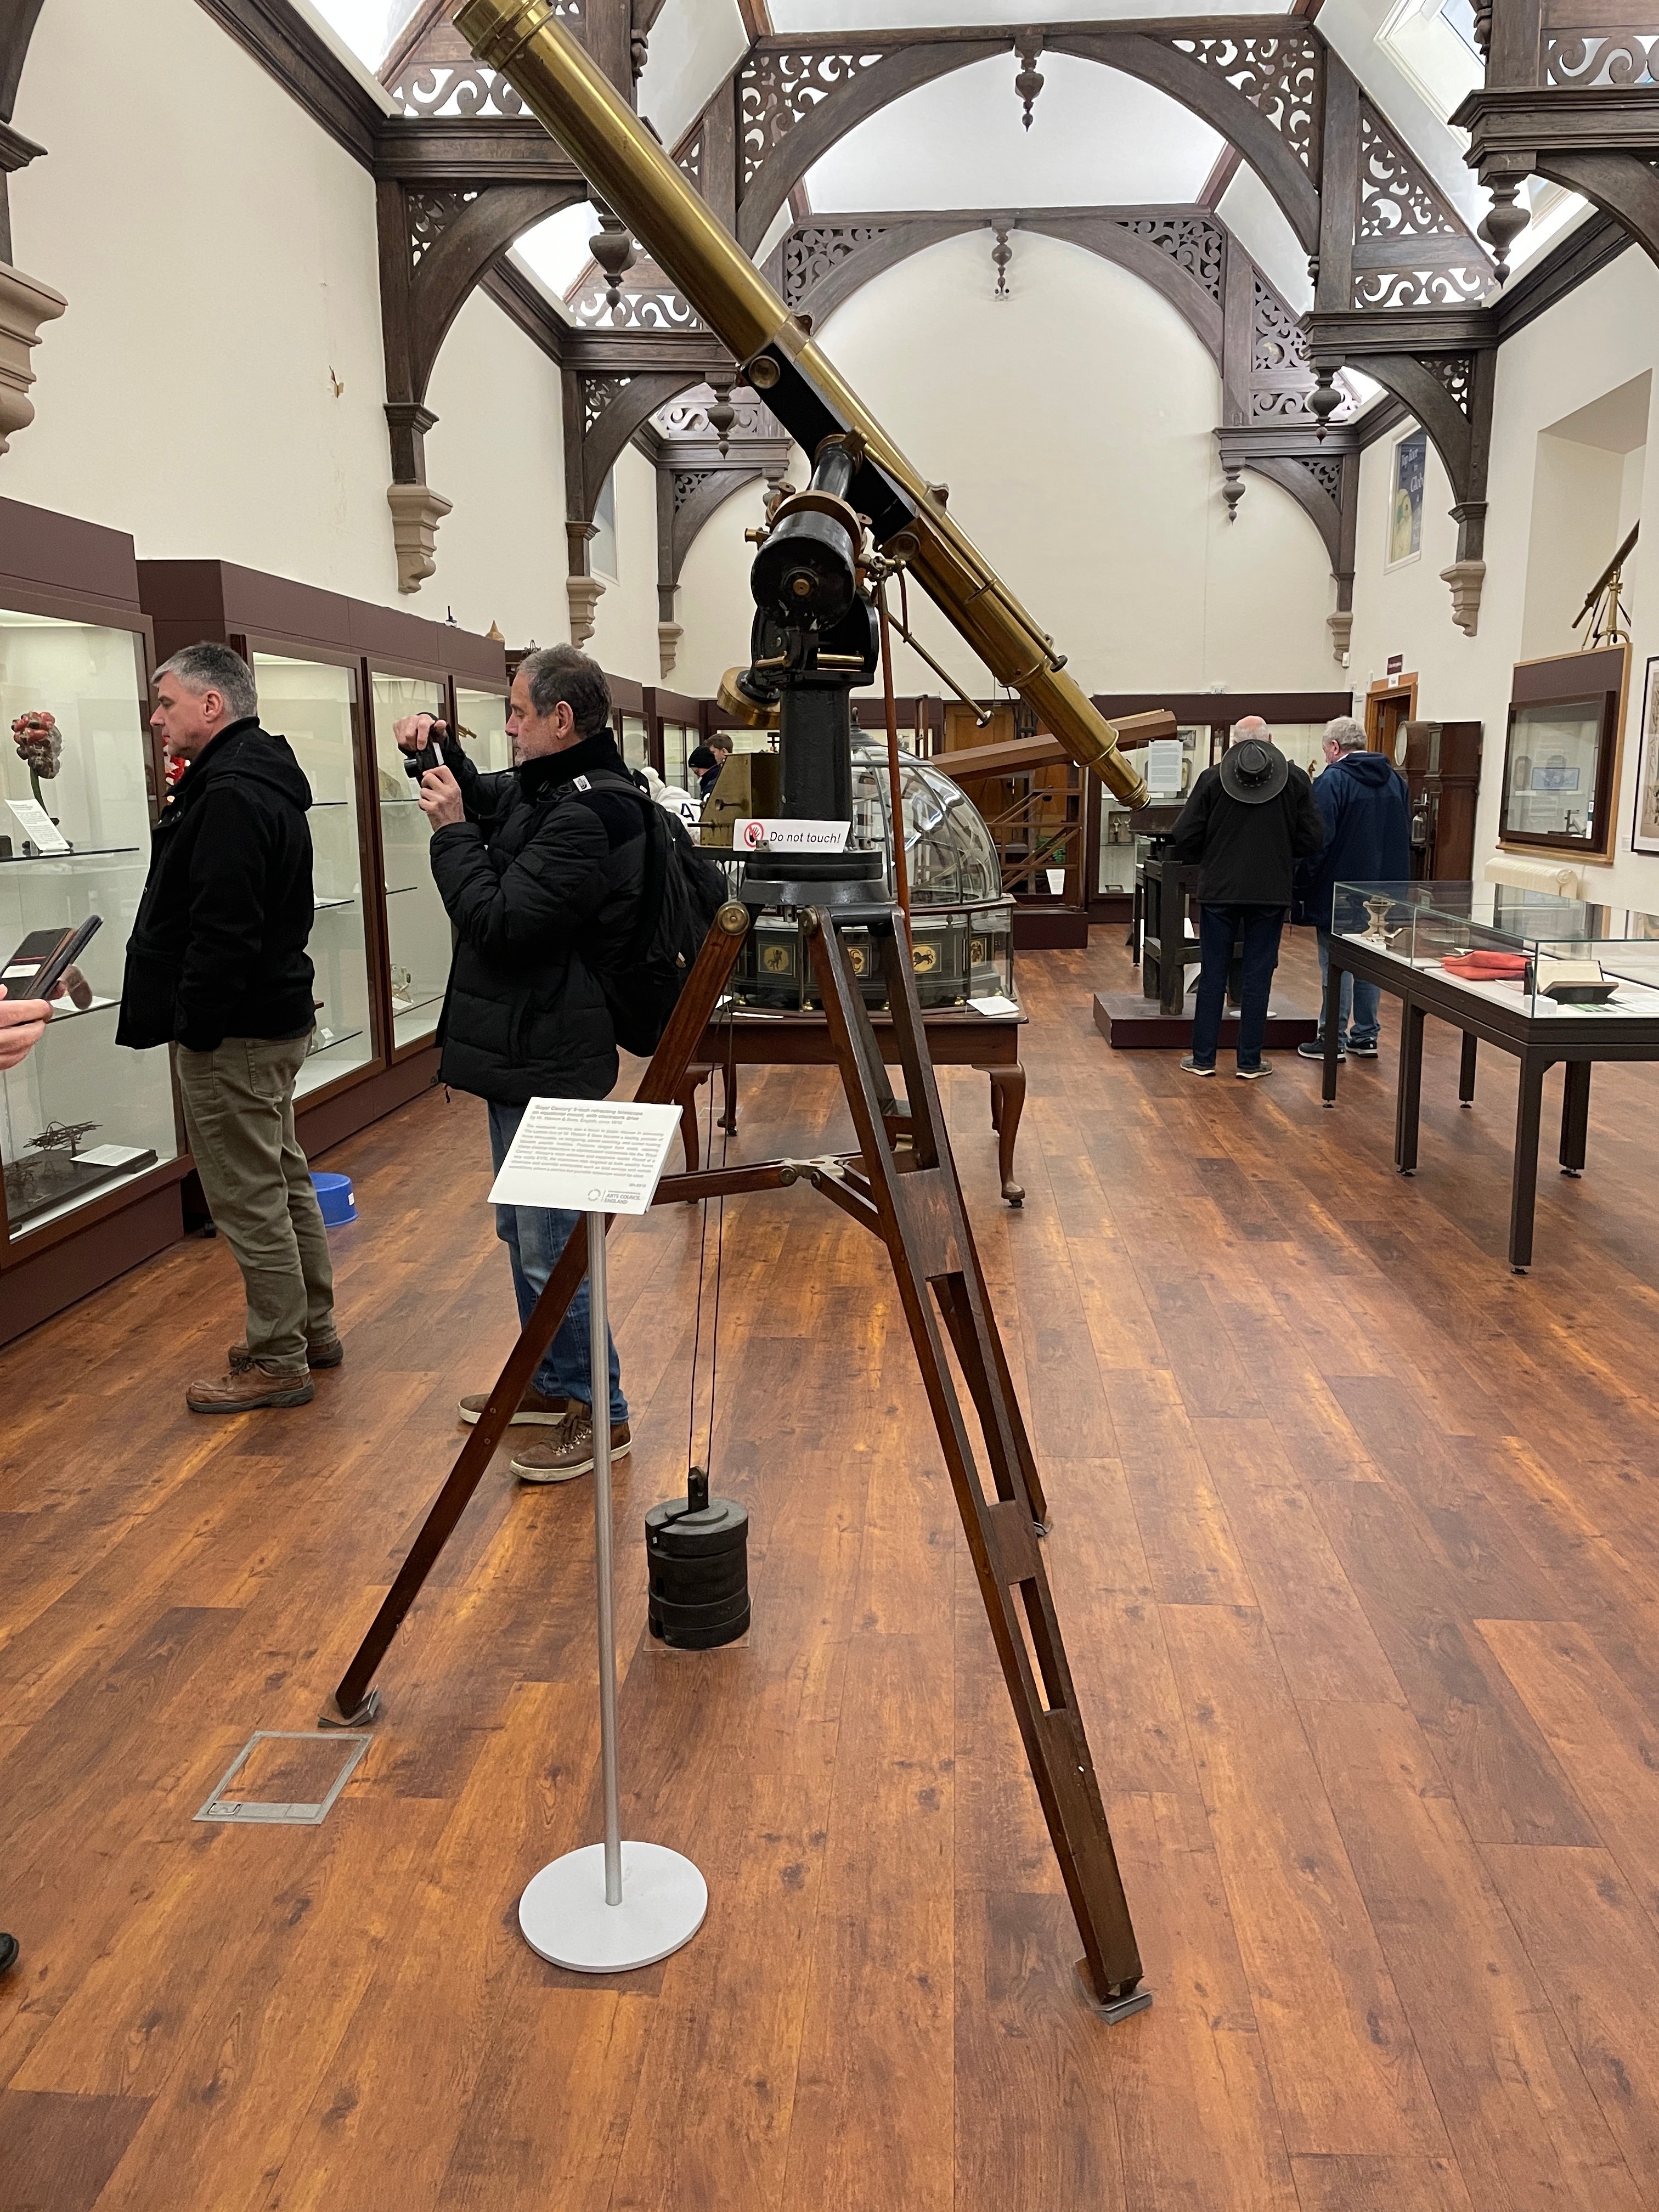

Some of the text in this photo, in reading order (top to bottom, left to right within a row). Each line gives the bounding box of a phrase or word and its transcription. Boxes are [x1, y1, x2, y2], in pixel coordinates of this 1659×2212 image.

[770, 832, 841, 843] Do not touch!
